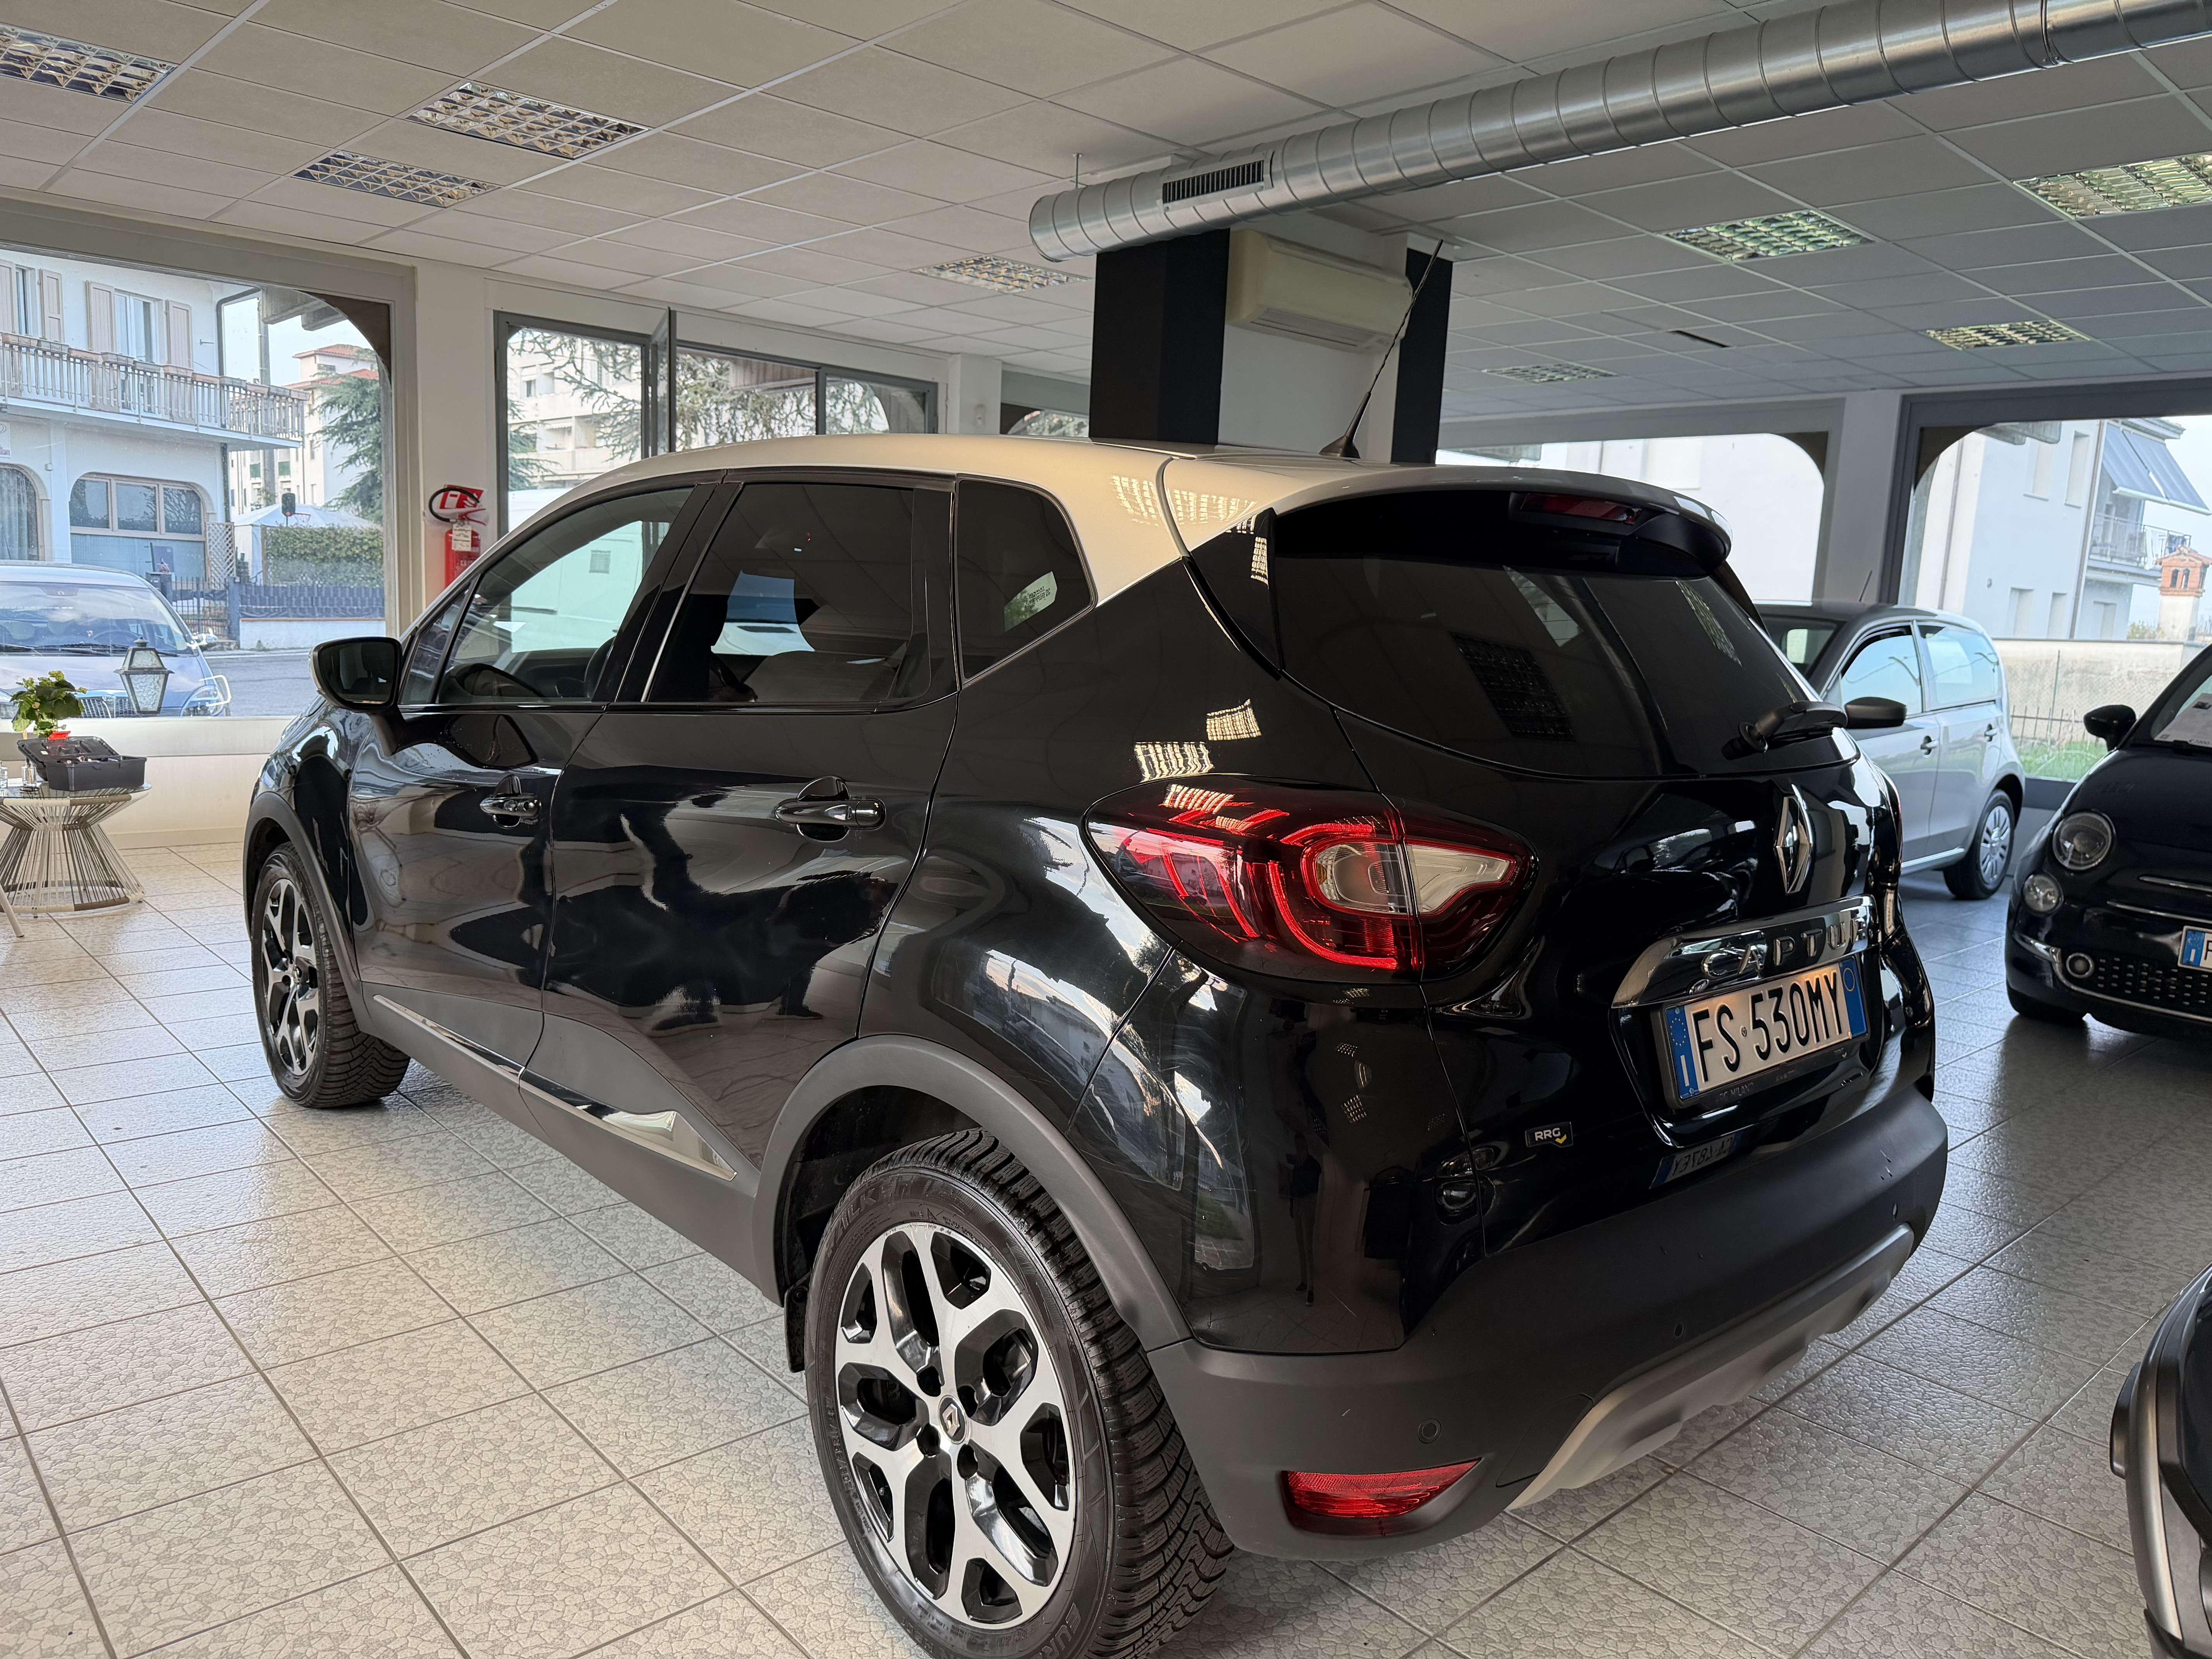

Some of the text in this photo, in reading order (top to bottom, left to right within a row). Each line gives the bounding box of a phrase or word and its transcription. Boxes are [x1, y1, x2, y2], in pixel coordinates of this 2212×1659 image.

[1701, 917, 1866, 978] CAPTUR
[1534, 1127, 1561, 1141] RRG
[855, 1501, 872, 1533] EXTRA LOAD
